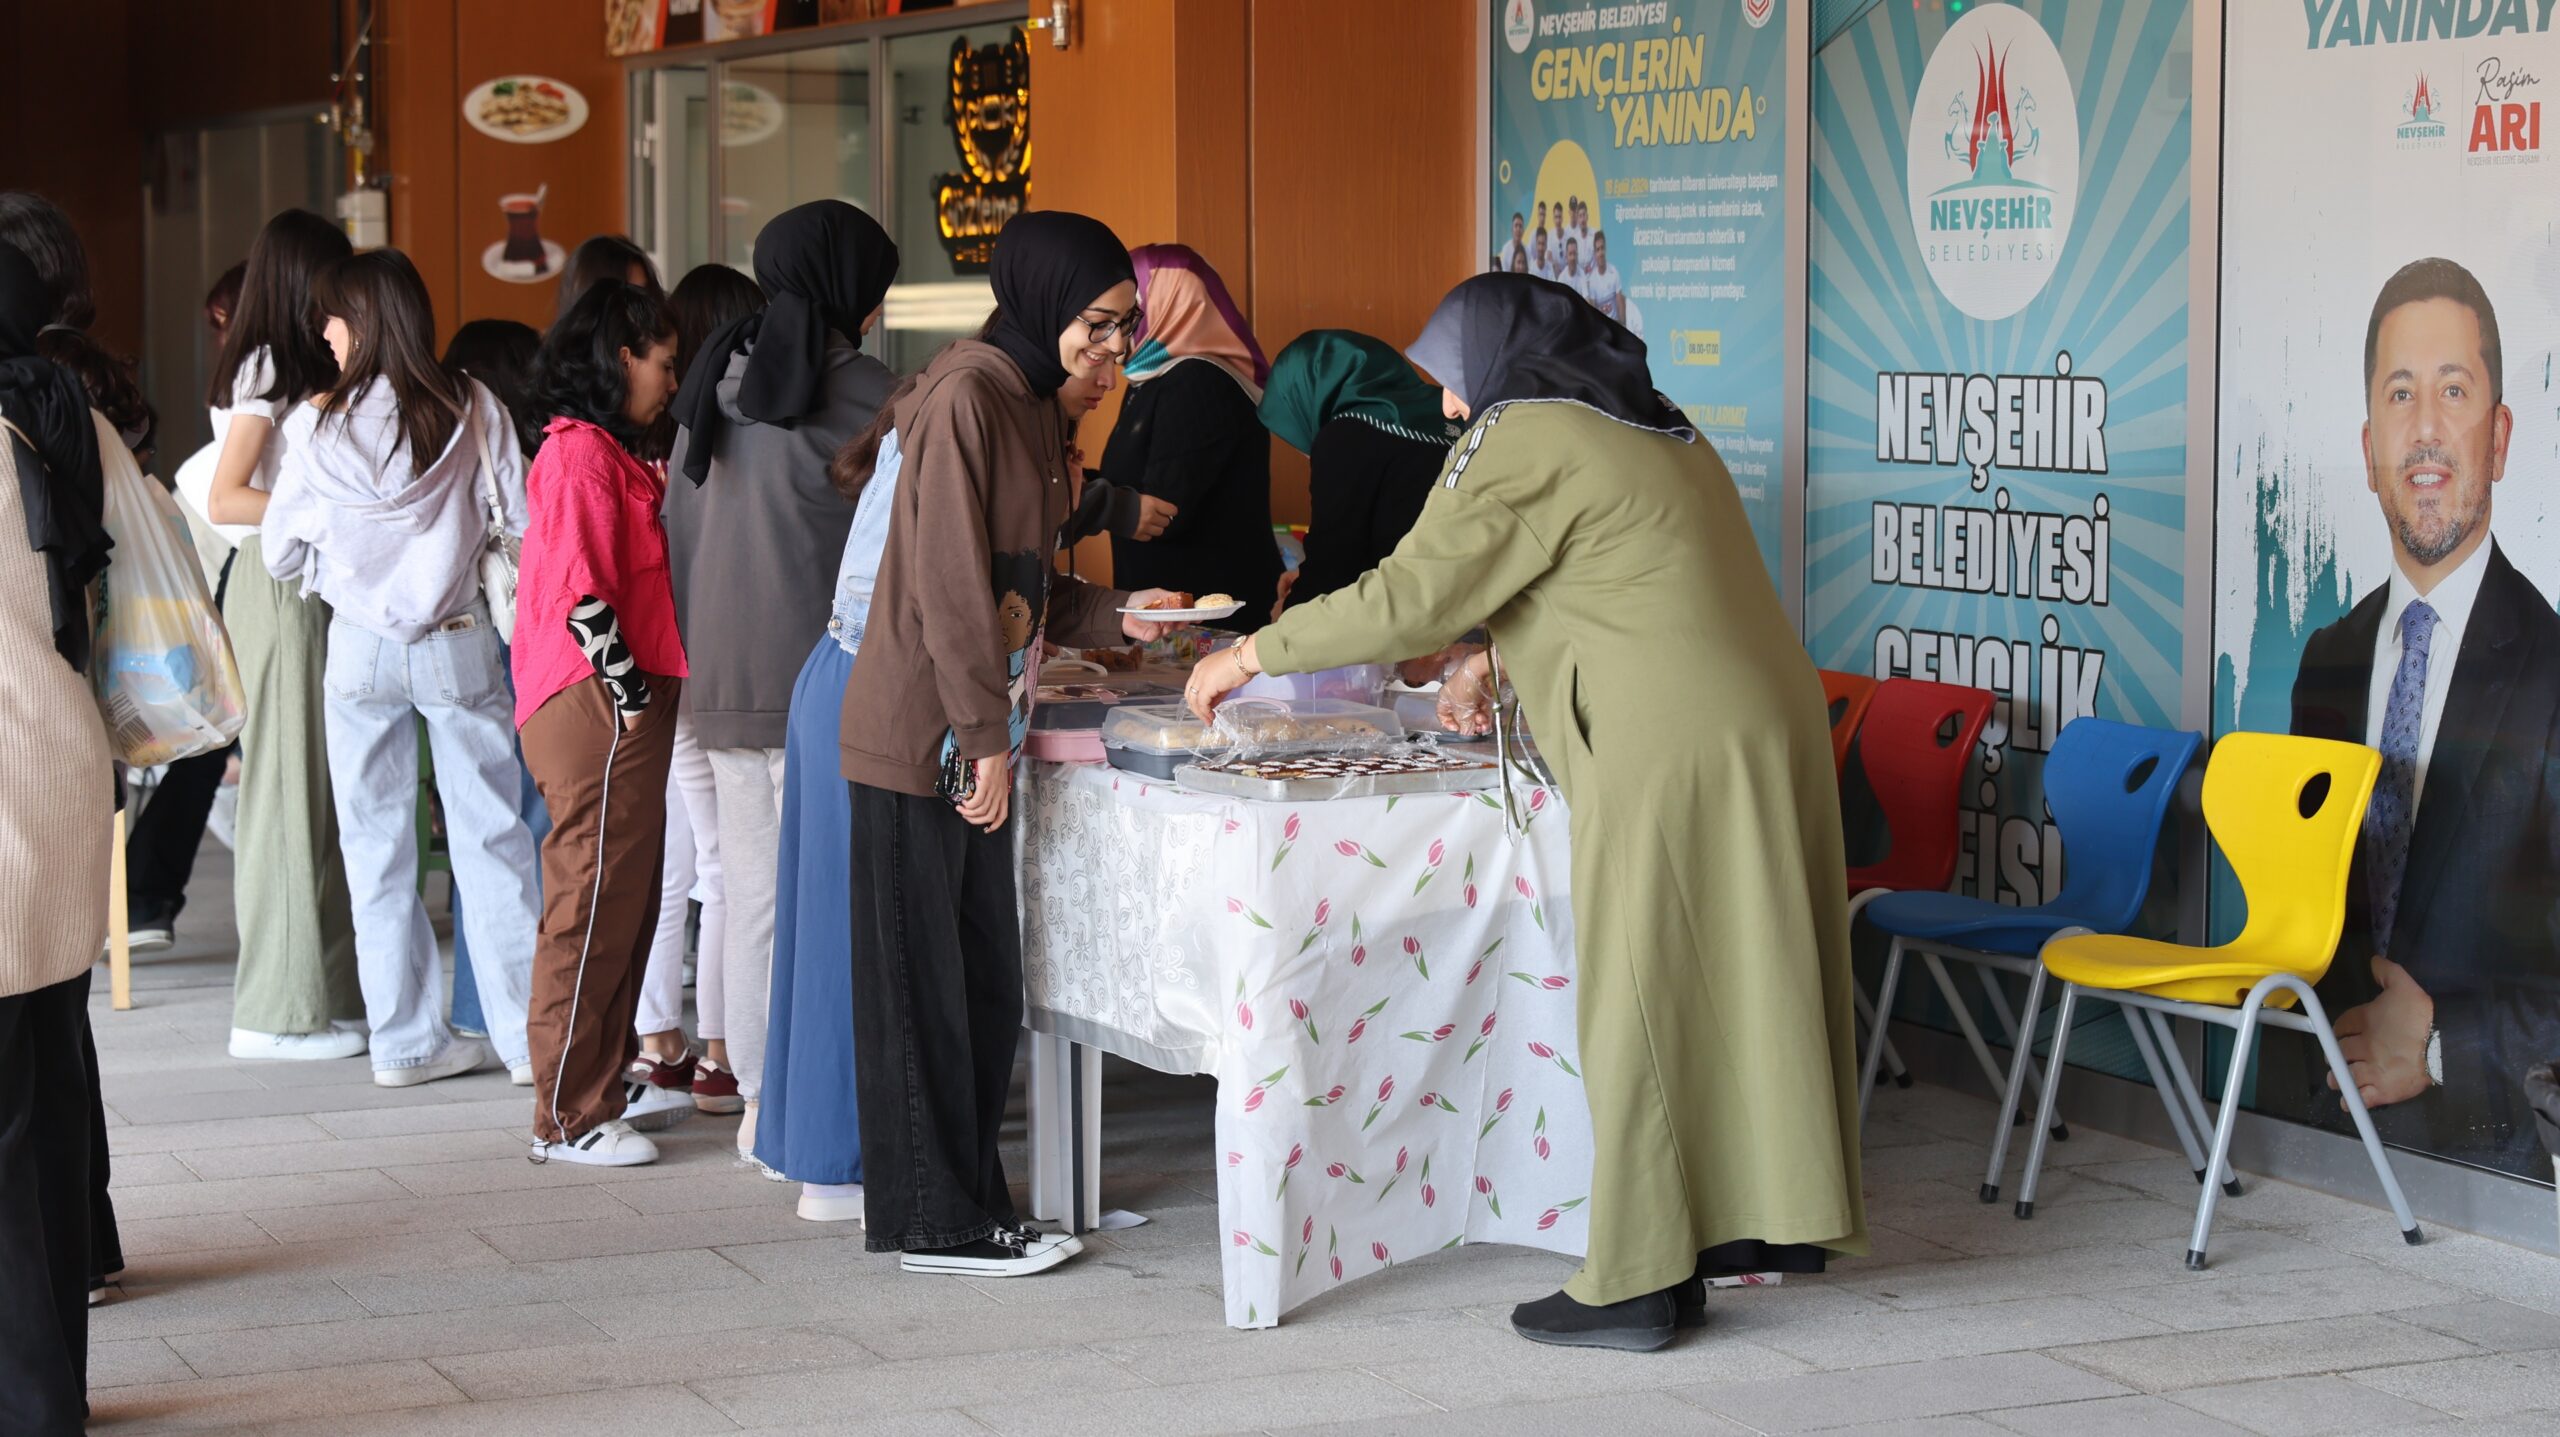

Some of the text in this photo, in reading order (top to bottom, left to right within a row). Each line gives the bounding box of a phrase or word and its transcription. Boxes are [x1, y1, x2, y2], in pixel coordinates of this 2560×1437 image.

[1539, 3, 1597, 37] NEVŞEHİR
[1531, 16, 1705, 112] GENÇLERİN
[1611, 85, 1755, 149] YANINDA
[2468, 102, 2541, 152] ARI
[1877, 350, 2108, 493] NEVŞEHİR
[1872, 487, 2109, 607] BELEDİYESİ
